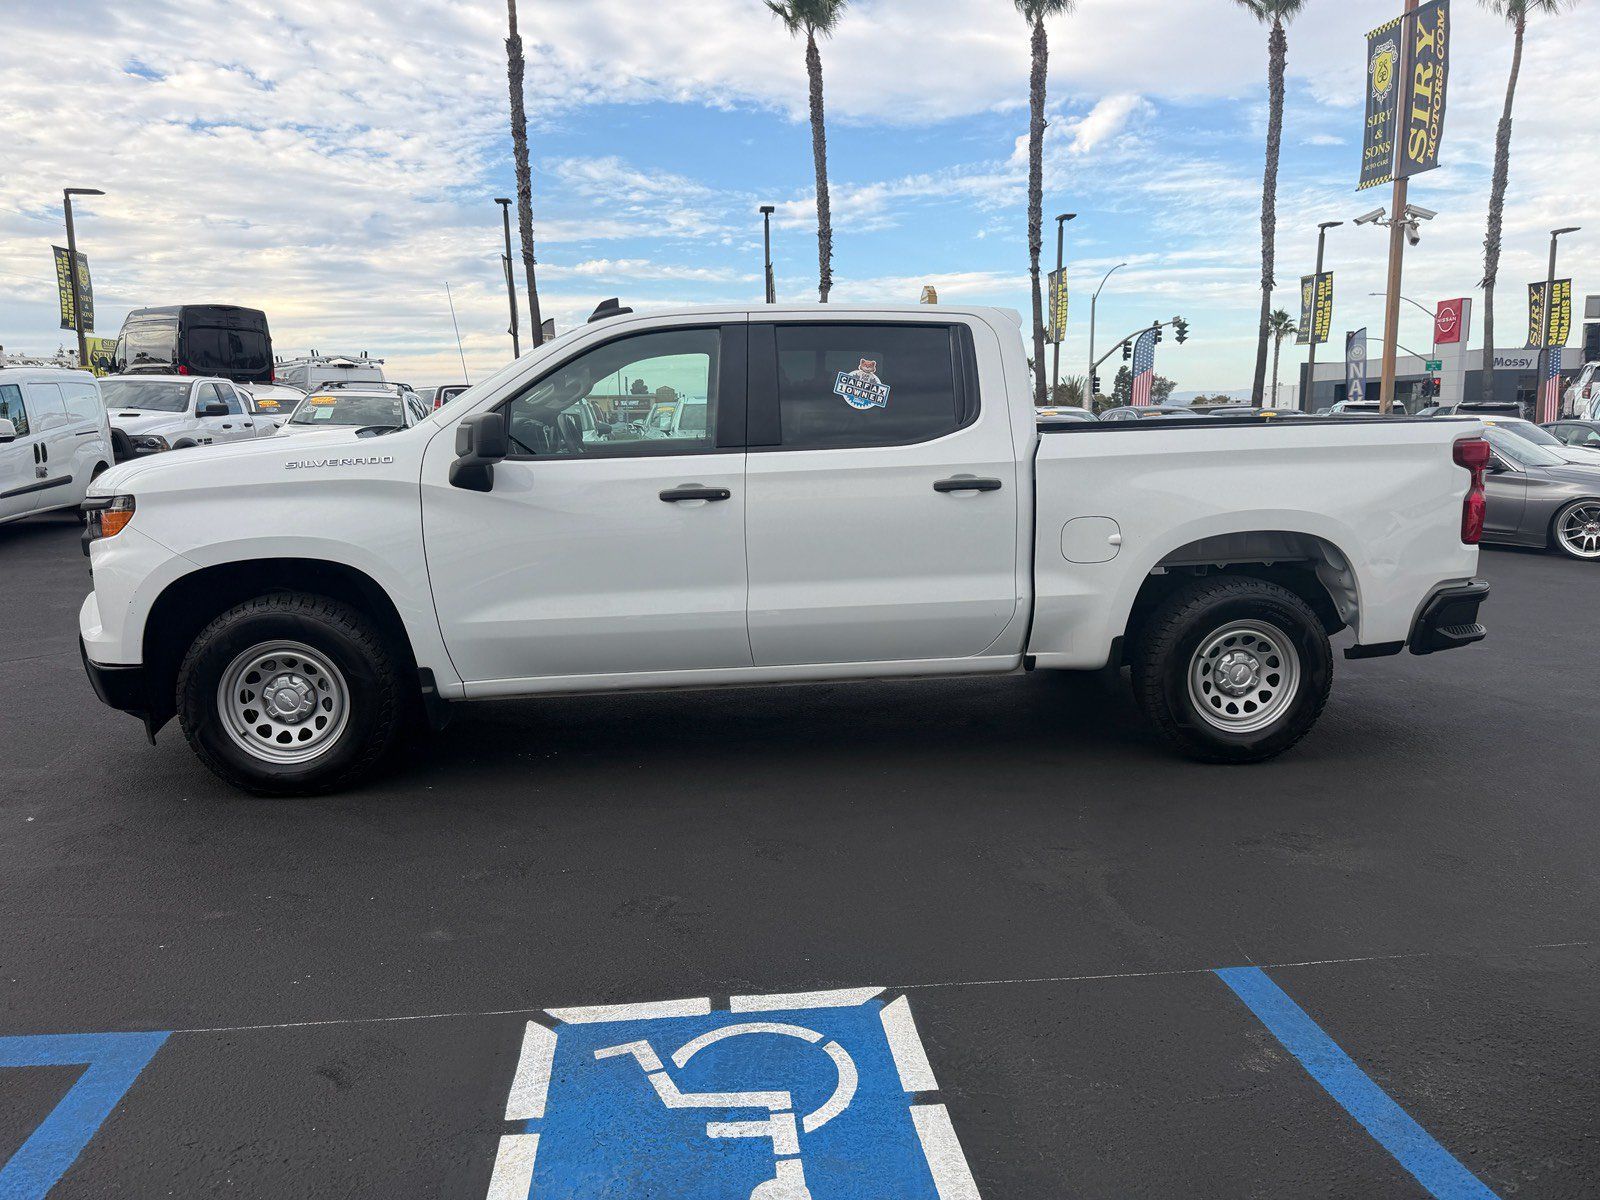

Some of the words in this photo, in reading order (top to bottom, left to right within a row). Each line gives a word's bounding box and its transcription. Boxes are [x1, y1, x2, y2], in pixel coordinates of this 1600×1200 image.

[1408, 15, 1435, 164] SIRY
[1426, 6, 1445, 160] MOTORS.COM
[1367, 107, 1393, 128] SIRY
[1375, 129, 1383, 140] &
[1364, 141, 1391, 160] SONS
[56, 256, 65, 288] AUTO
[61, 250, 70, 275] FULL
[67, 281, 75, 328] SERVICE
[1317, 281, 1325, 308] AUTO
[1551, 283, 1561, 305] OUR
[1561, 281, 1570, 298] WE
[60, 289, 69, 320] CARE
[1529, 286, 1540, 347] SIRY
[1315, 309, 1323, 336] CARE
[1320, 300, 1331, 341] SERVICE
[1548, 306, 1561, 346] TROOPS
[1557, 299, 1570, 345] SUPPORT
[1493, 357, 1533, 369] Mossy
[838, 384, 845, 392] 1
[846, 387, 884, 404] OWNER
[840, 376, 886, 396] CARFAX
[284, 455, 394, 470] SILVERADO
